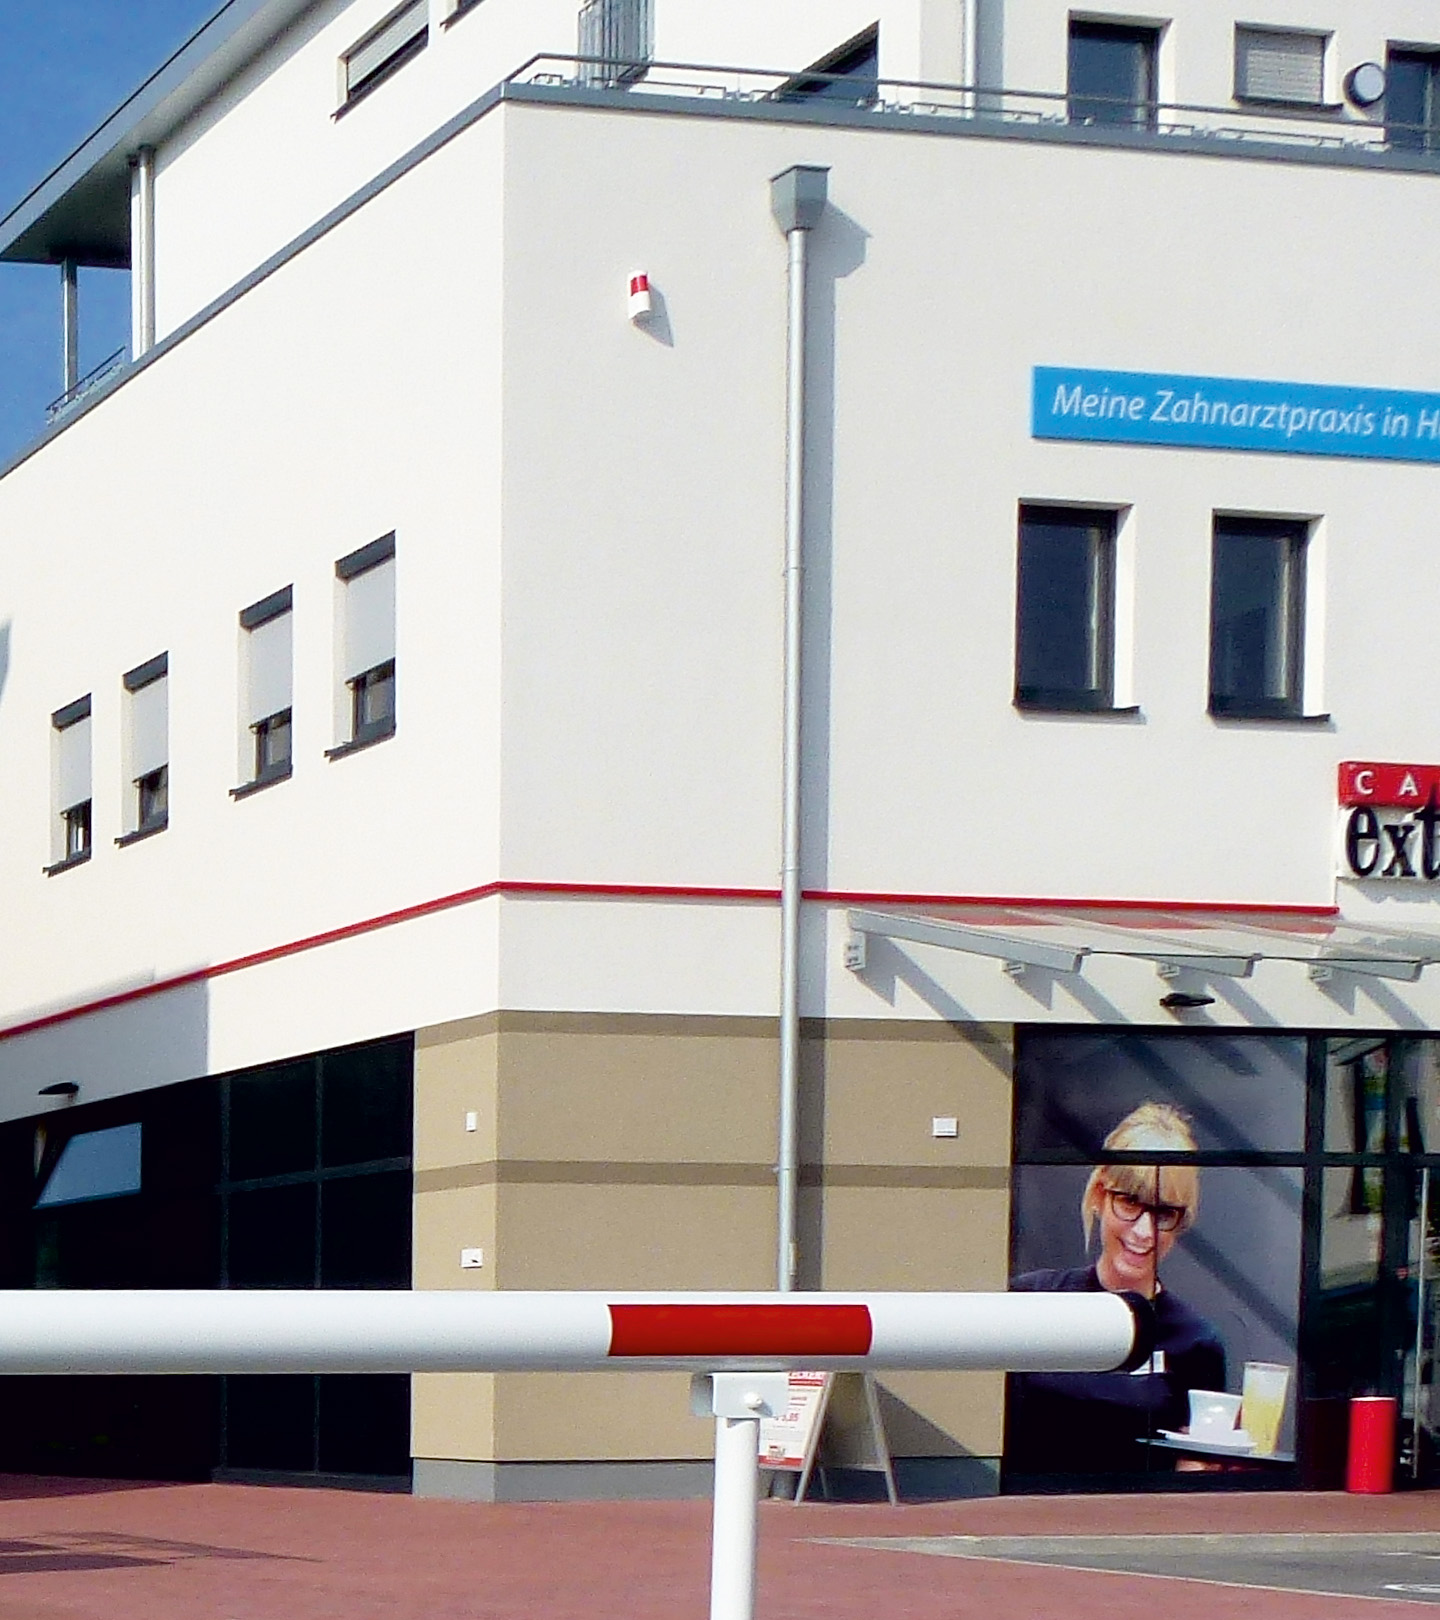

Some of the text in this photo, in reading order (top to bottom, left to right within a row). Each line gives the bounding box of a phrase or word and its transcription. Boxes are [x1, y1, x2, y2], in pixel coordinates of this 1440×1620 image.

[1052, 384, 1440, 440] Meine Zahnarztpraxis in H
